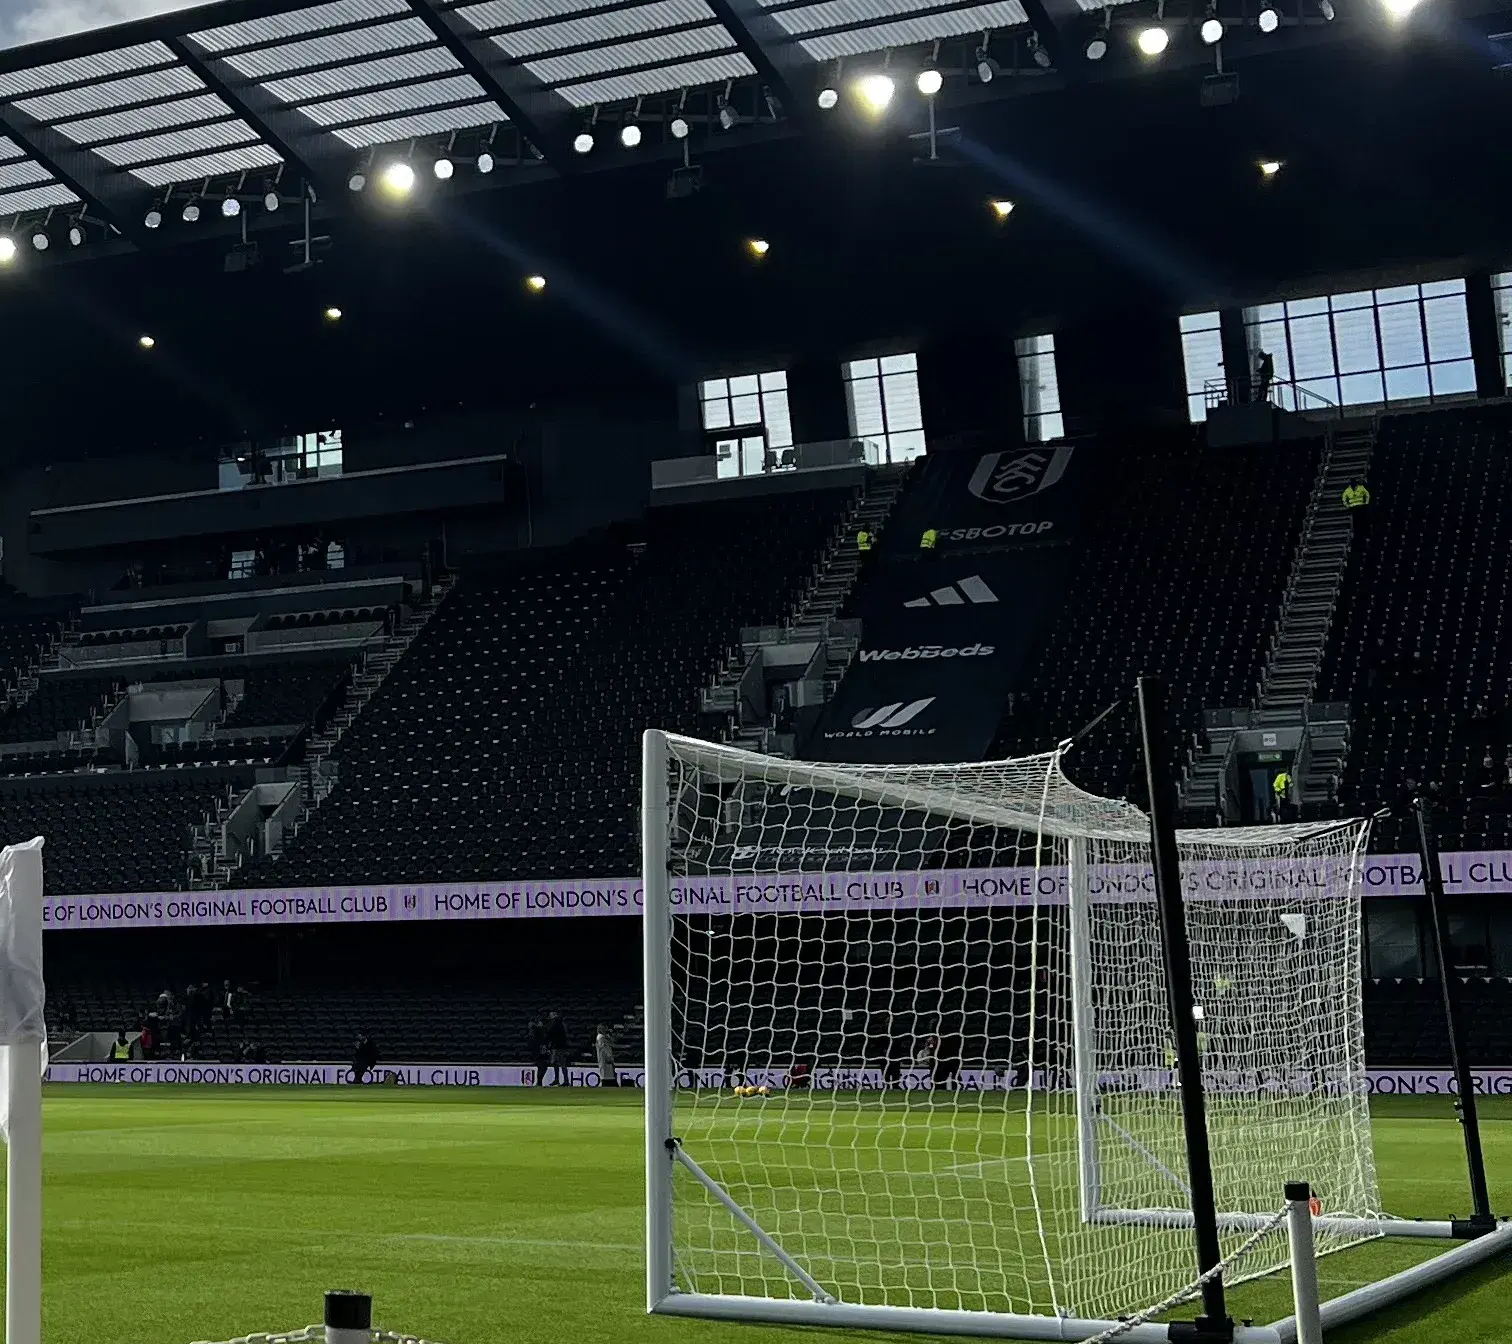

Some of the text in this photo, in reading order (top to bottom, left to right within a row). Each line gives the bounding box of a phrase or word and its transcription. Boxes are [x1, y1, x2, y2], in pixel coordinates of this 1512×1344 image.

[949, 520, 1056, 541] SBOTOP
[824, 727, 937, 739] WORLD MOBILE
[434, 893, 490, 911] HOME
[495, 892, 521, 909] OF
[526, 889, 628, 909] LONDON'S
[737, 883, 841, 903] FOOTBALL
[846, 881, 905, 901] CLUB
[962, 877, 1033, 897] HOME
[1038, 876, 1069, 895] OF
[54, 906, 76, 921] OF
[79, 904, 163, 921] LONDON'S
[166, 901, 246, 918] ORIGINAL
[250, 898, 337, 916] FOOTBALL
[340, 895, 388, 913] CLUB
[78, 1067, 126, 1083] HOME
[130, 1067, 153, 1083] OF
[157, 1068, 244, 1084] LONDON'S
[248, 1068, 330, 1084] ORIGINAL
[431, 1069, 480, 1086] CLUB
